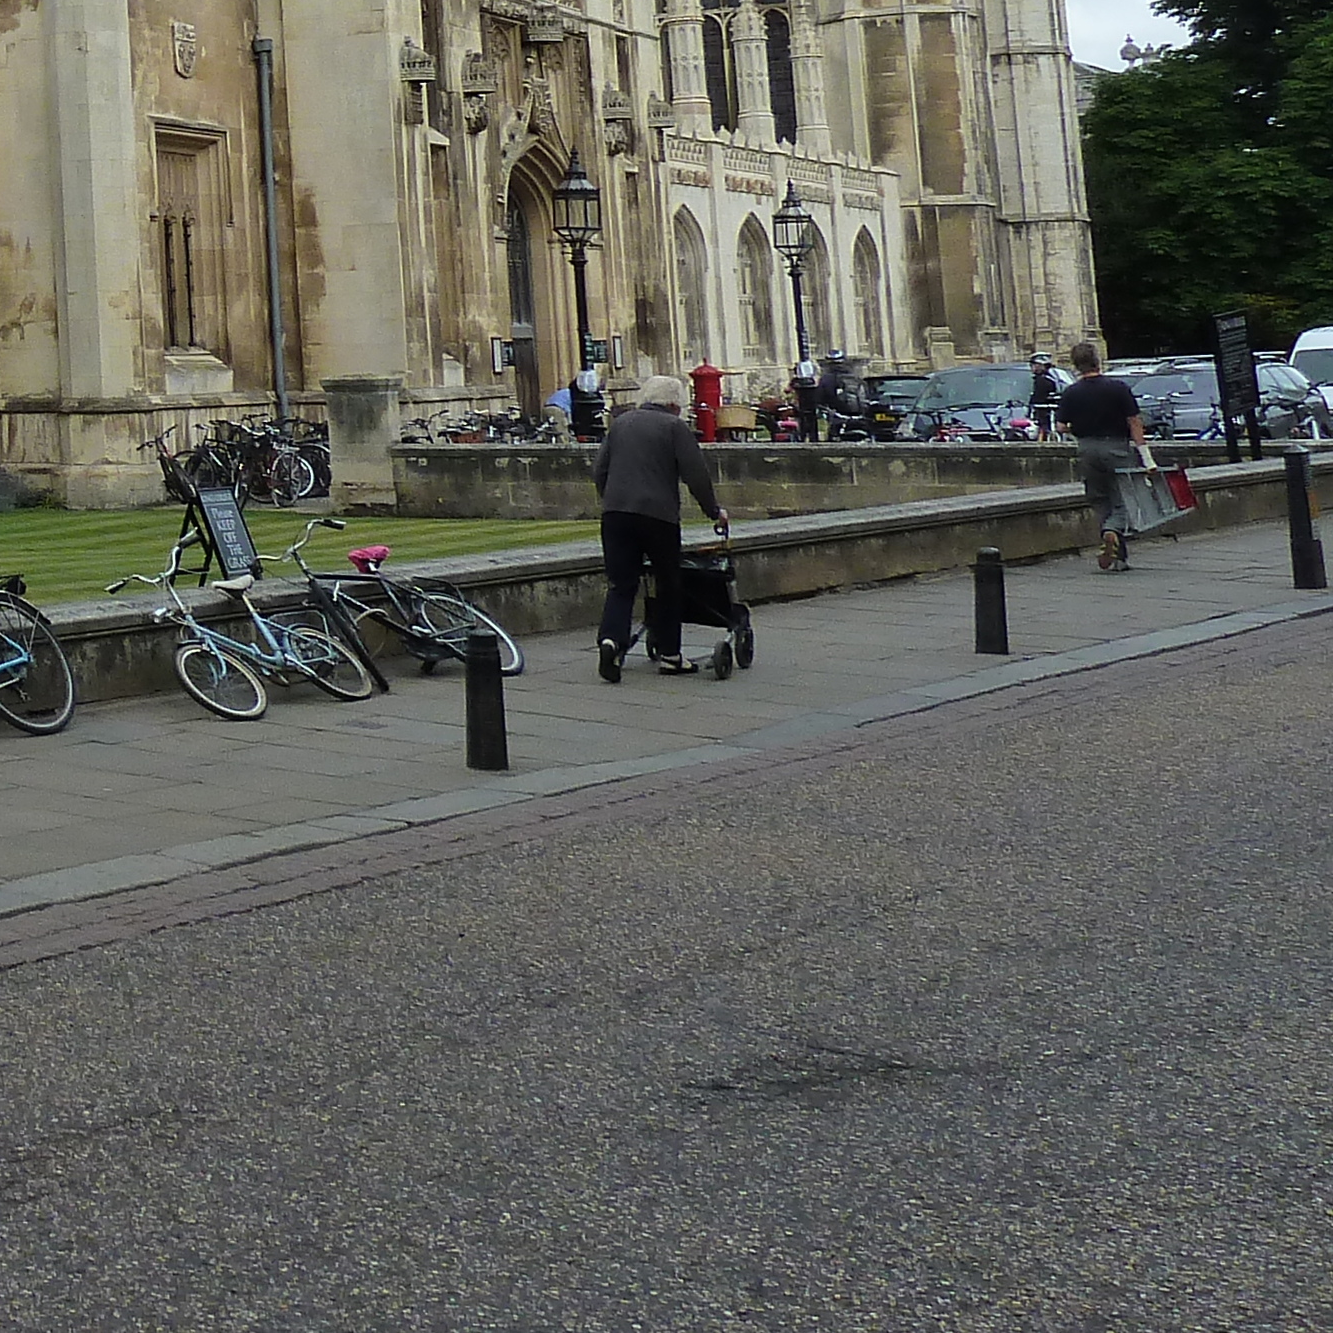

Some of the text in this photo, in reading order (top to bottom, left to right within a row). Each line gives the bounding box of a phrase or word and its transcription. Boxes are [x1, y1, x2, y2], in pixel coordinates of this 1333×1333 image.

[216, 519, 236, 531] KEEP
[223, 531, 237, 543] OFF
[226, 543, 244, 556] THE
